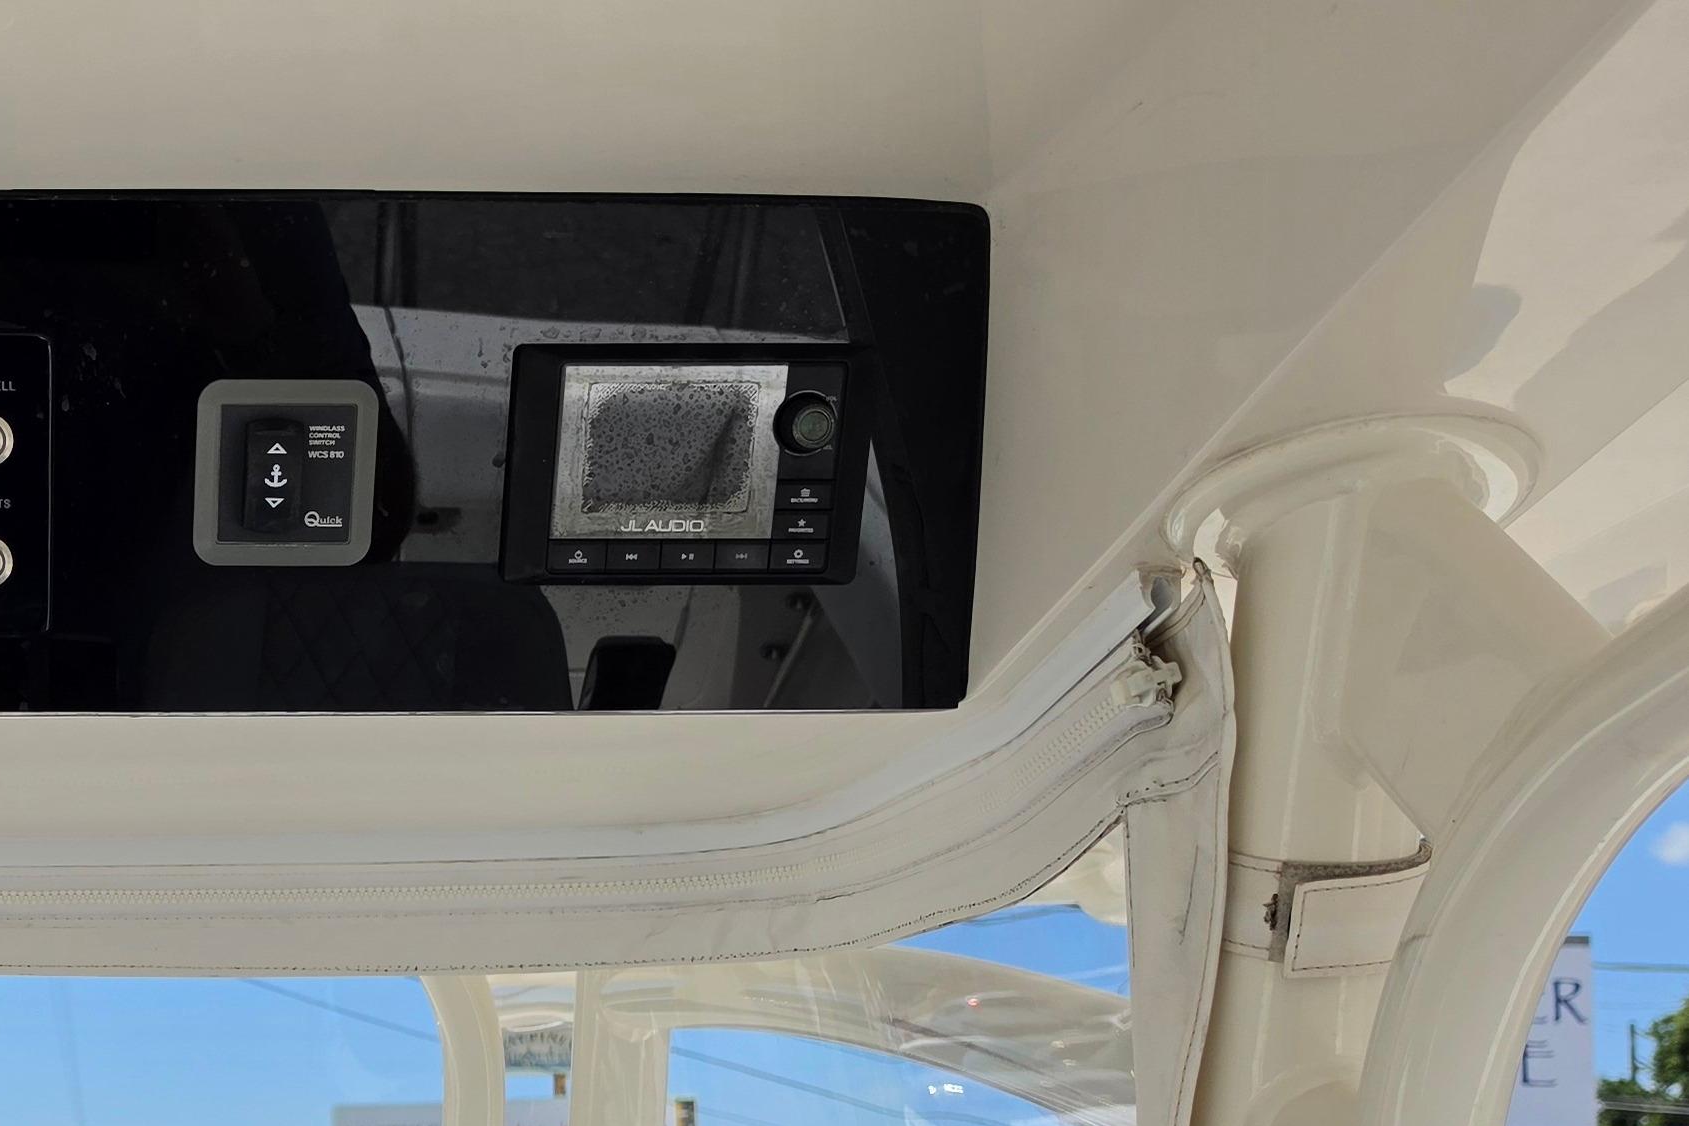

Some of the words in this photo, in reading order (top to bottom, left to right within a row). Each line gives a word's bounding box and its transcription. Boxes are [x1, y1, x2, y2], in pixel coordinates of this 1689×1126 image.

[308, 450, 329, 459] WCS
[329, 450, 345, 459] 810
[304, 511, 343, 527] Quick
[620, 519, 643, 532] JL
[644, 519, 705, 532] AUDIO
